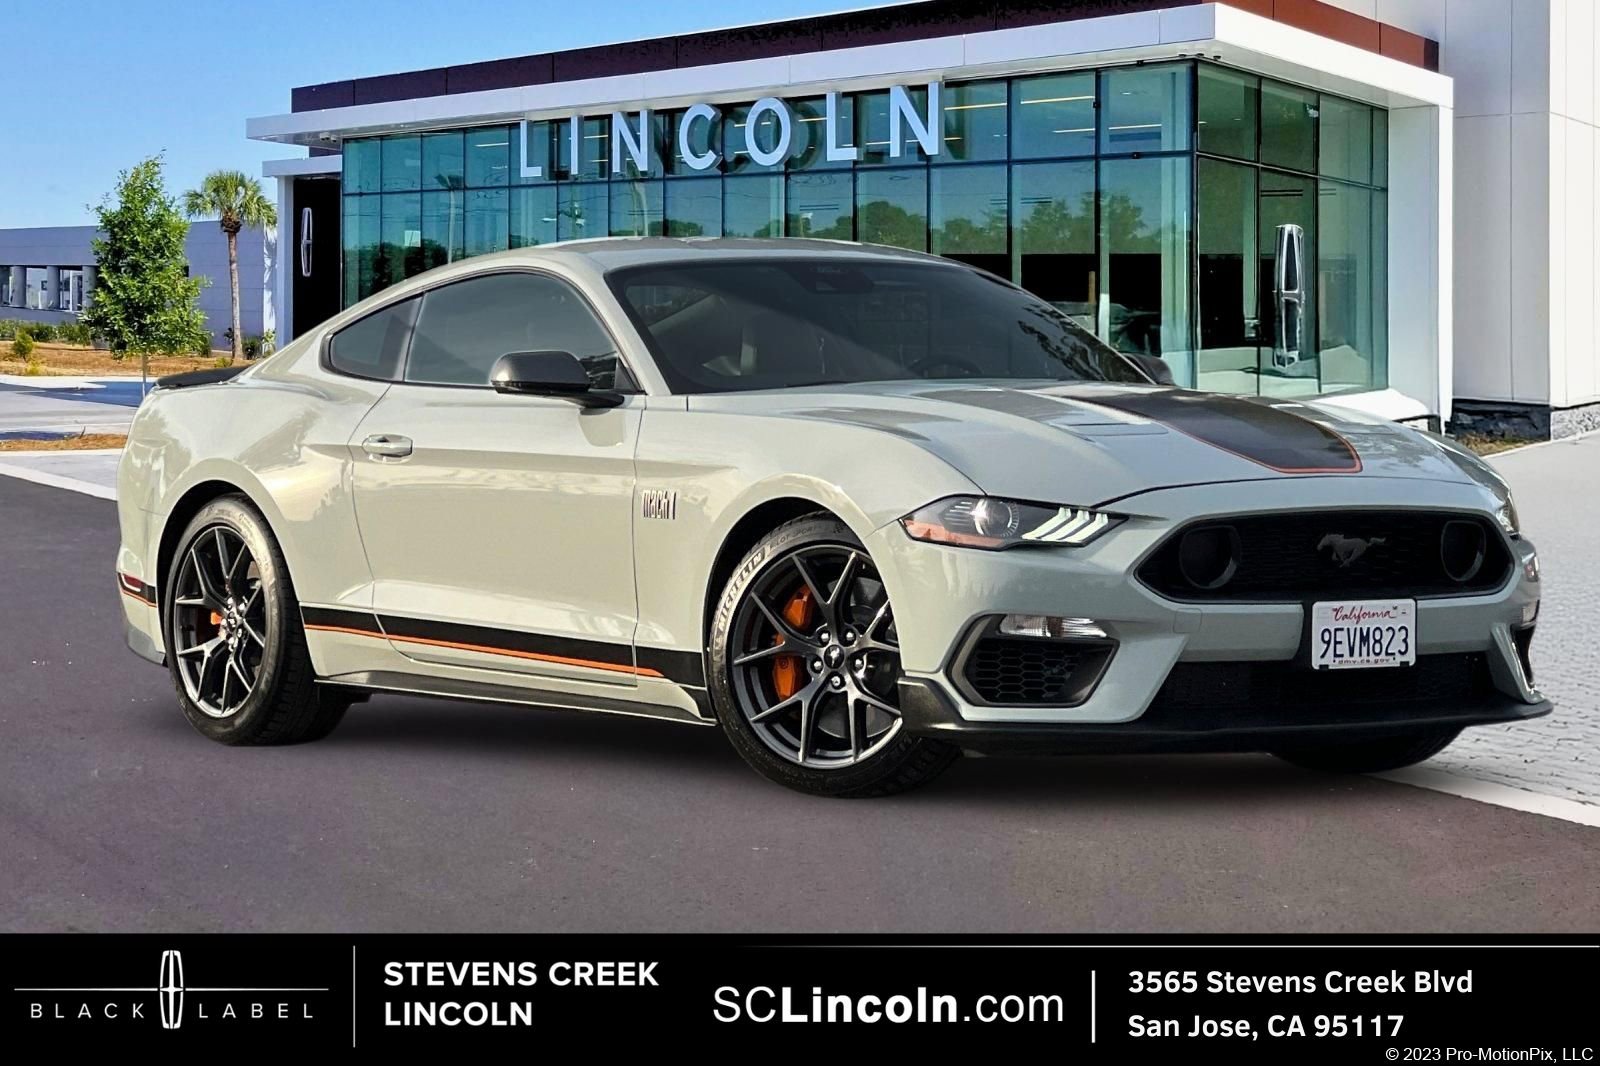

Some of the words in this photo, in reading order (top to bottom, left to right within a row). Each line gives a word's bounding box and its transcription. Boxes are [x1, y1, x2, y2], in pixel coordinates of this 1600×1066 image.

[519, 80, 943, 178] LINCOLN
[716, 551, 765, 633] MICHELIN
[1332, 605, 1397, 625] California
[1319, 625, 1409, 659] 9EVM823
